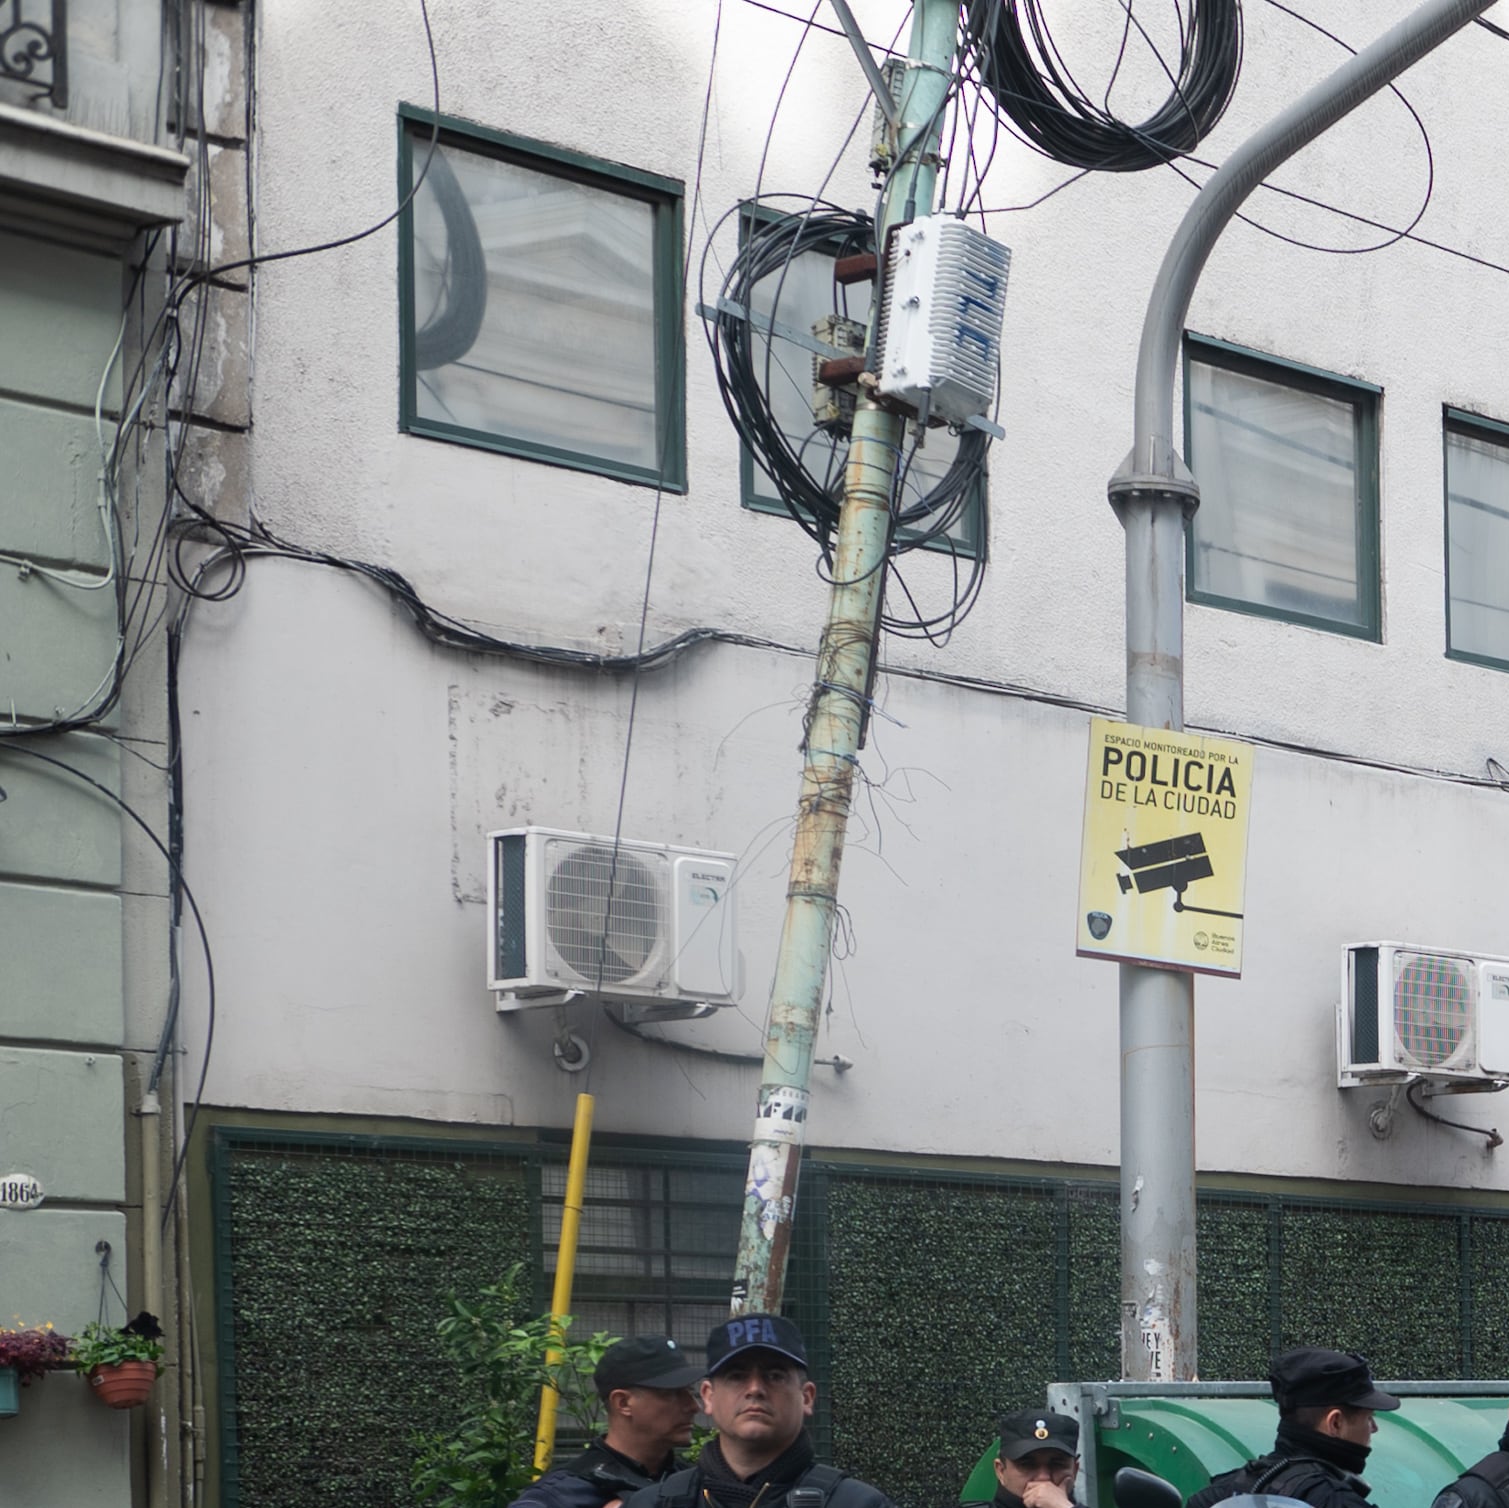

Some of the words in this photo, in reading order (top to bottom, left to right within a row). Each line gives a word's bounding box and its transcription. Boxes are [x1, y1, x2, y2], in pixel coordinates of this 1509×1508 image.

[1104, 734, 1141, 749] ESPACIO
[1143, 740, 1206, 760] MONITOREADO
[1208, 751, 1226, 764] POR
[1228, 755, 1239, 765] LA
[1102, 746, 1237, 798] POLICIA
[1100, 780, 1127, 802] DE
[1134, 785, 1158, 807] LA
[1163, 790, 1237, 820] CIUDAD
[1, 1181, 43, 1203] 1864
[727, 1318, 779, 1347] PFA
